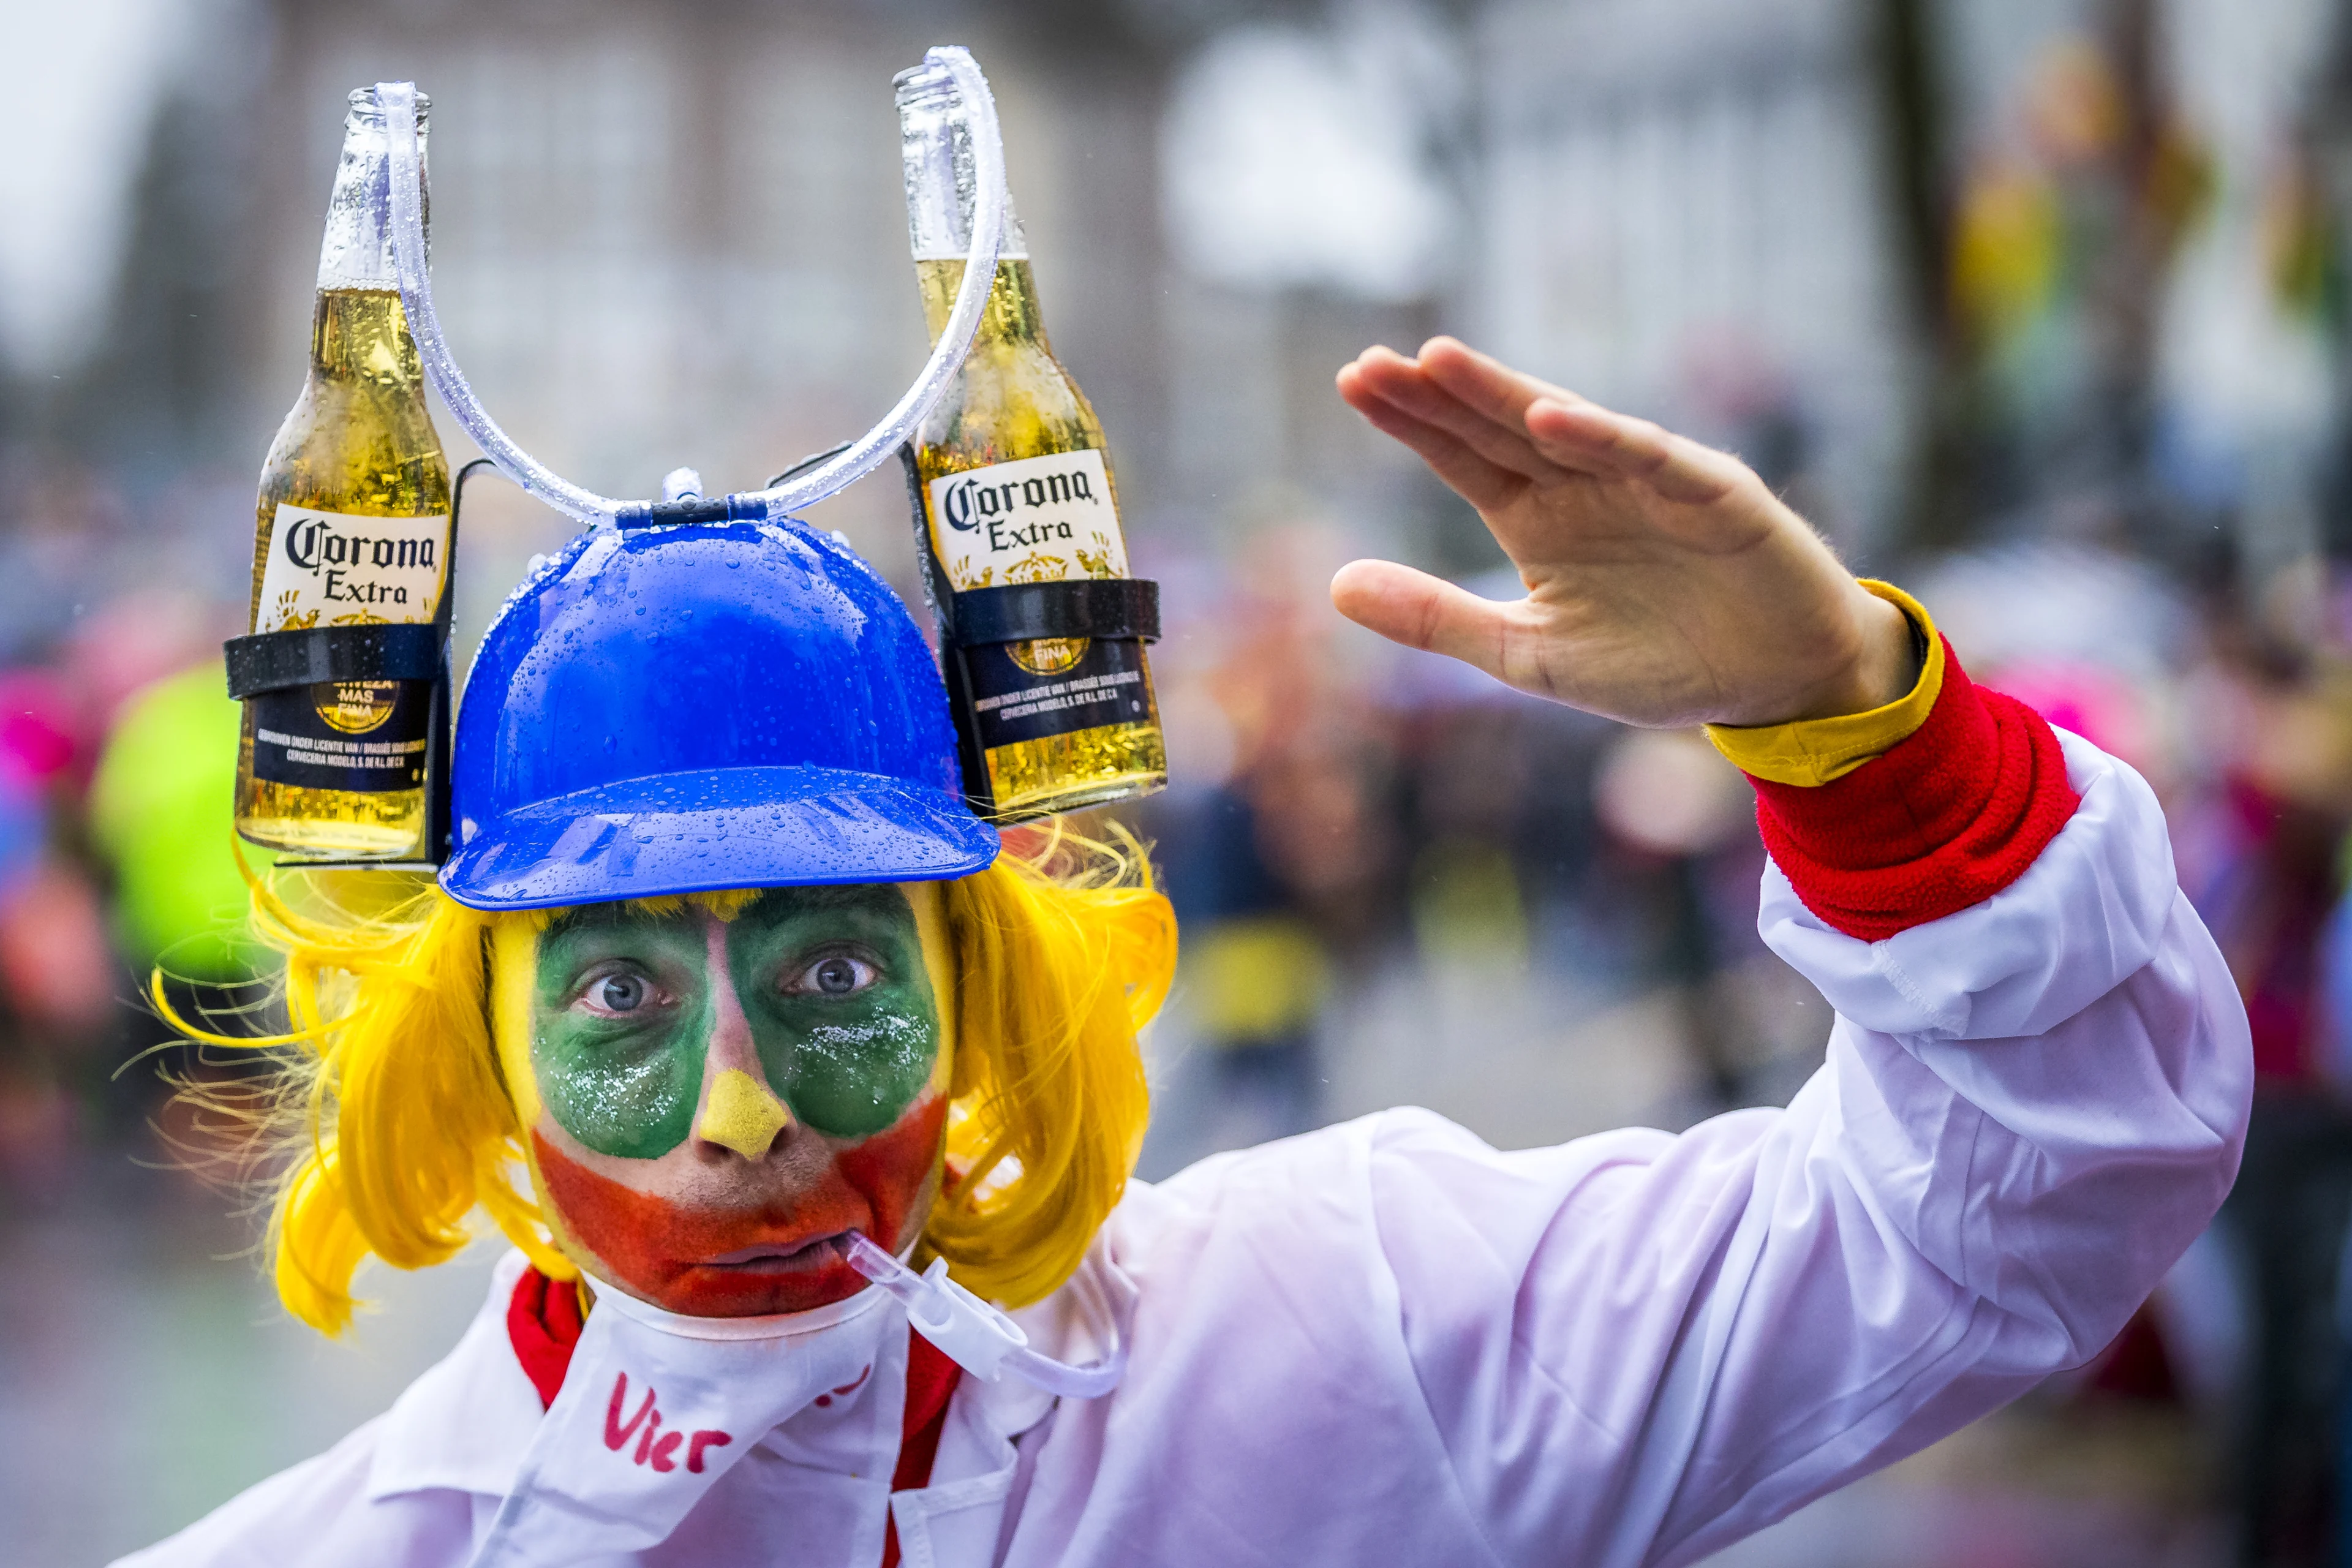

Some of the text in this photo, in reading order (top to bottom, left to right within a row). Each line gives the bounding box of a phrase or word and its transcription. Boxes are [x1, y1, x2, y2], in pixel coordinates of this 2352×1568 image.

[943, 469, 1093, 534] Corona
[284, 518, 434, 576] Corona
[986, 519, 1072, 552] Extra
[323, 568, 408, 604] Extra
[1033, 644, 1071, 662] FINA
[337, 688, 374, 704] MAS
[337, 703, 373, 717] FINA
[603, 1370, 733, 1474] Vier
